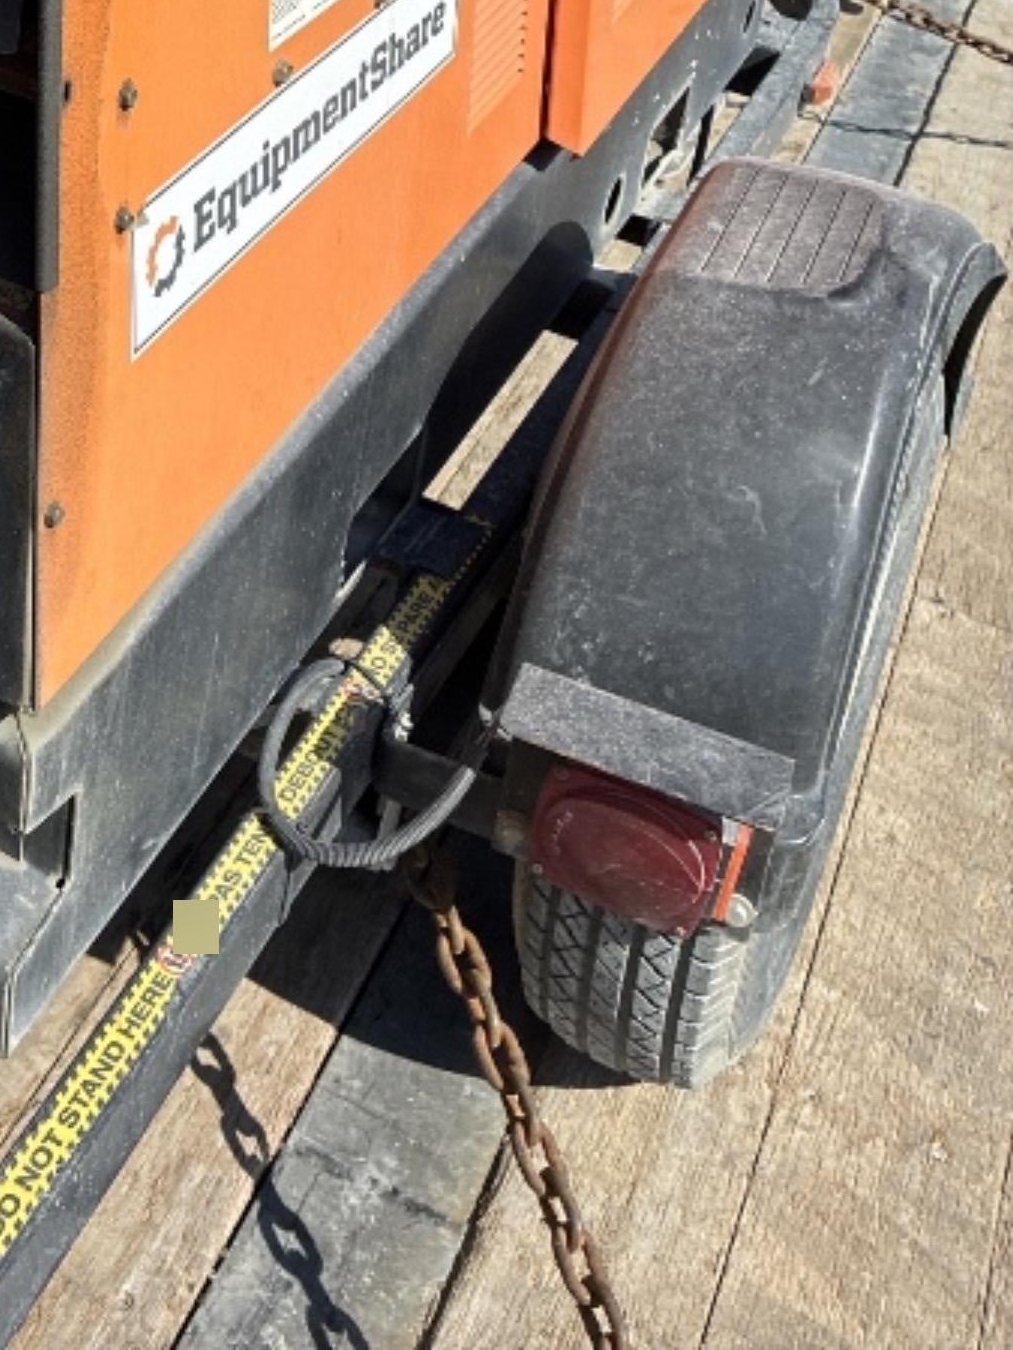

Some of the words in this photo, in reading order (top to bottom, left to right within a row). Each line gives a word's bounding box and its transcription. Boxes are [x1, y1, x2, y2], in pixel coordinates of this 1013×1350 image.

[192, 0, 446, 253] EquipmentShare
[15, 1127, 65, 1193] NOT
[56, 1038, 128, 1130] STAND
[121, 974, 174, 1044] HERE
